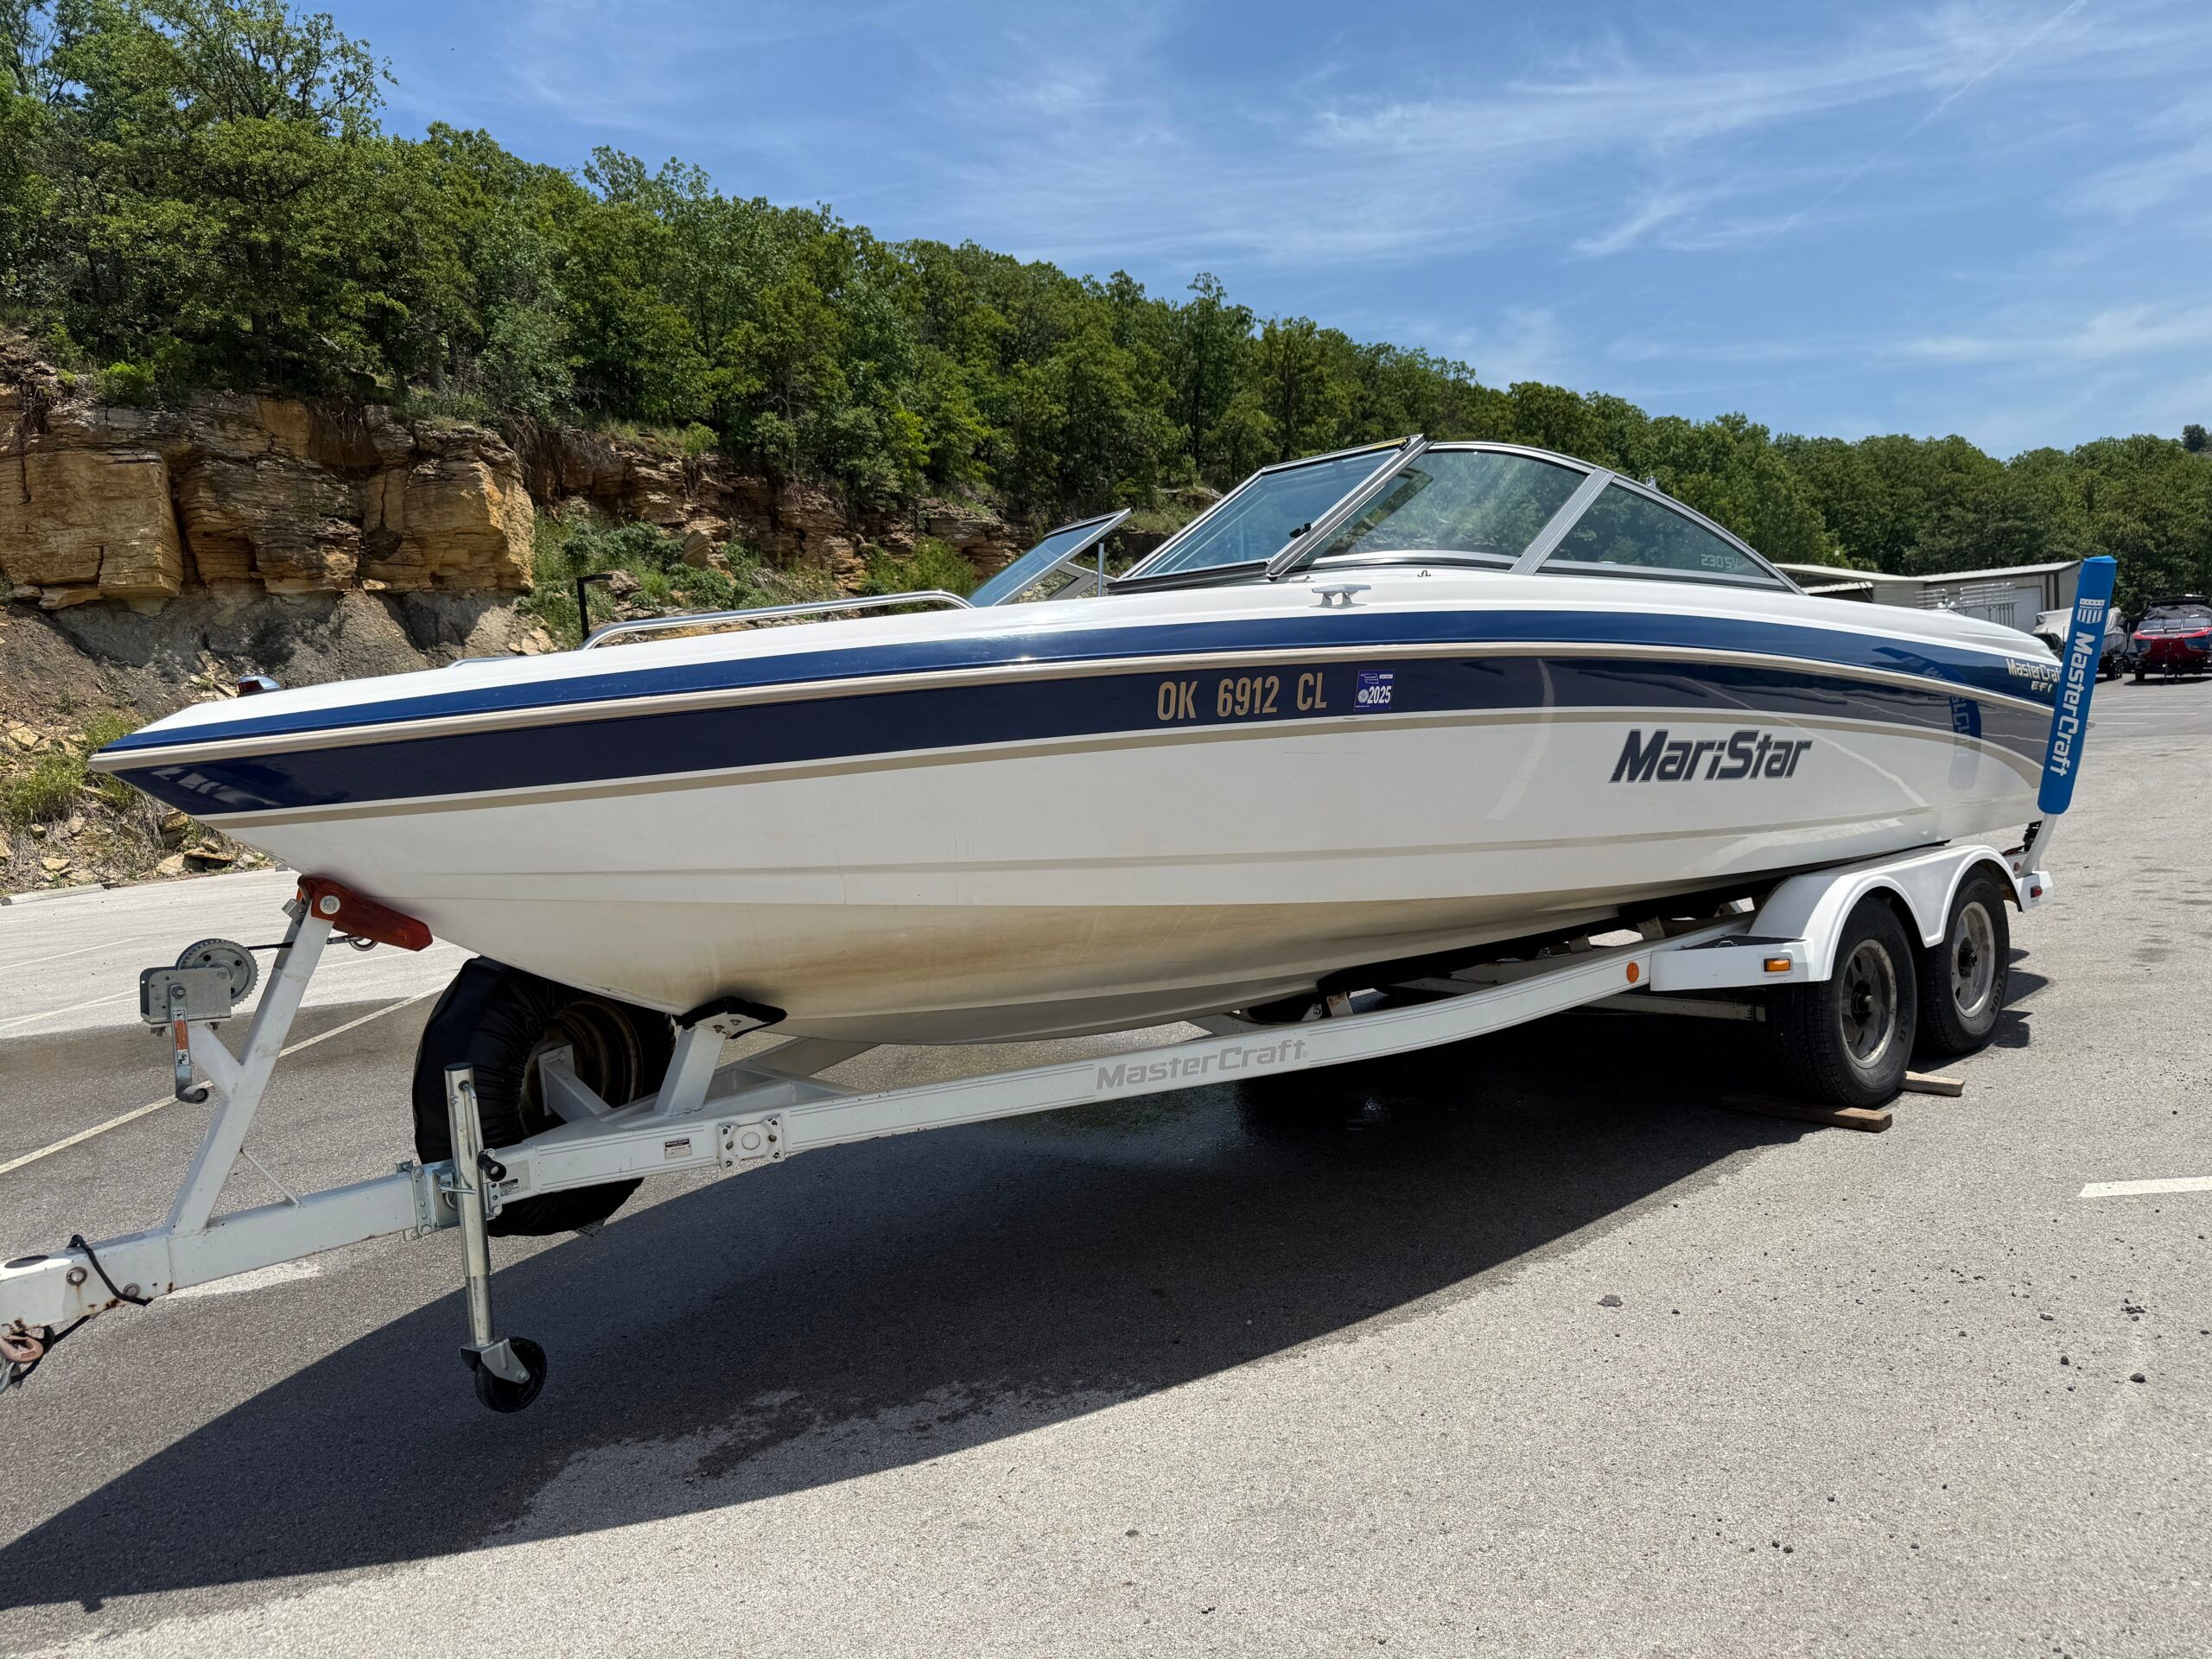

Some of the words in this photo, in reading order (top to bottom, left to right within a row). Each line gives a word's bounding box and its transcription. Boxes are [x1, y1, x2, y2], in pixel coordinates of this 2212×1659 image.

[1367, 685, 1391, 704] 2025
[2005, 658, 2062, 683] MasterCraf
[1157, 680, 1198, 721] OK
[1217, 676, 1280, 717] 6912
[1297, 672, 1327, 712] CL
[2050, 631, 2095, 777] MasterCraft
[1608, 728, 1814, 783] MariStar
[1096, 1039, 1306, 1090] MasterCraft
